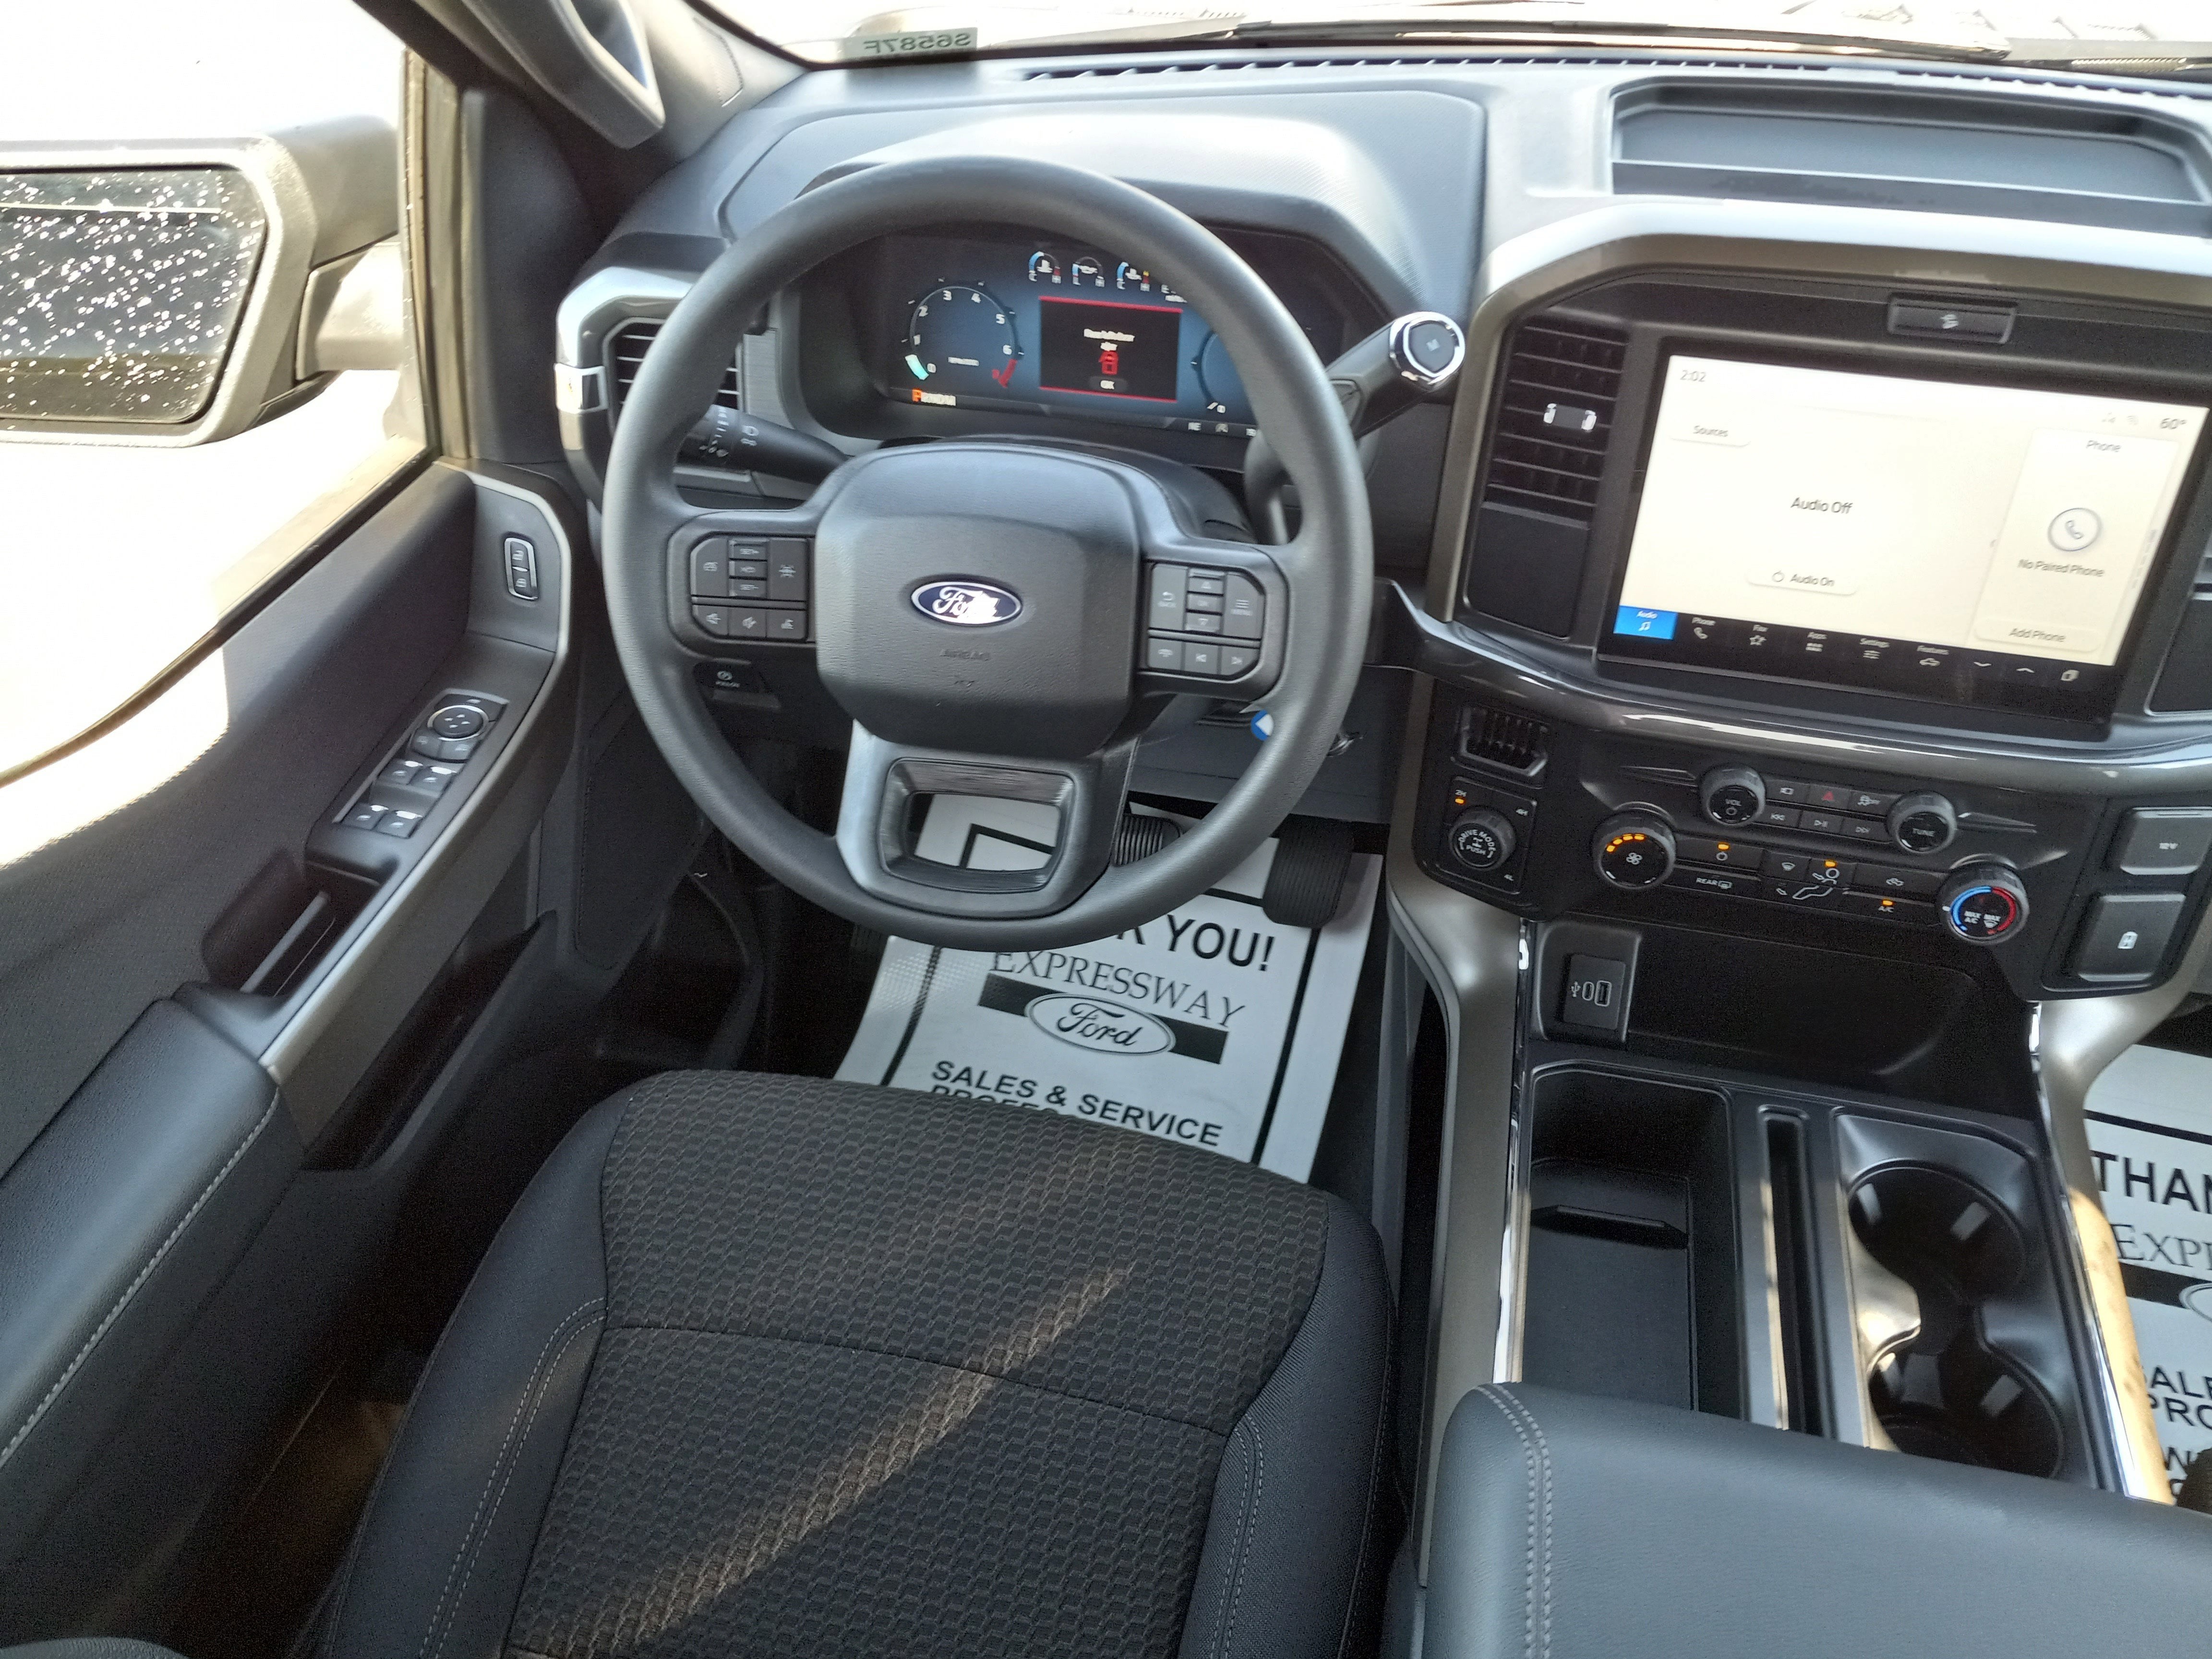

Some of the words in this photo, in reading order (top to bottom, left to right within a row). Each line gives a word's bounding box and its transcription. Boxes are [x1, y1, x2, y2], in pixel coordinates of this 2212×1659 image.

[943, 290, 952, 301] 3
[918, 305, 928, 317] 2
[996, 313, 1005, 324] 5
[1003, 345, 1012, 355] 6
[1680, 370, 1707, 383] 2:02
[1693, 425, 1729, 437] Sources
[2086, 440, 2121, 452] Phone
[1791, 497, 1828, 513] Audio
[1831, 502, 1853, 515] Off
[2034, 561, 2069, 573] Paired
[2069, 565, 2105, 577] Phone
[1790, 574, 1820, 586] Audio
[1820, 577, 1836, 588] On
[2009, 628, 2032, 638] Add
[2032, 630, 2066, 642] Phone
[1912, 828, 1936, 837] TUNE
[1479, 831, 1496, 852] MODE
[1696, 877, 1718, 886] REAR
[1167, 914, 1275, 972] YOU!
[989, 951, 1245, 1028] EXPRESSWAY
[1057, 1002, 1143, 1046] Ford
[931, 1059, 1038, 1099] SALES
[1045, 1085, 1067, 1107] &
[1077, 1094, 1223, 1147] SERVICE
[2109, 1223, 2212, 1271] EXP
